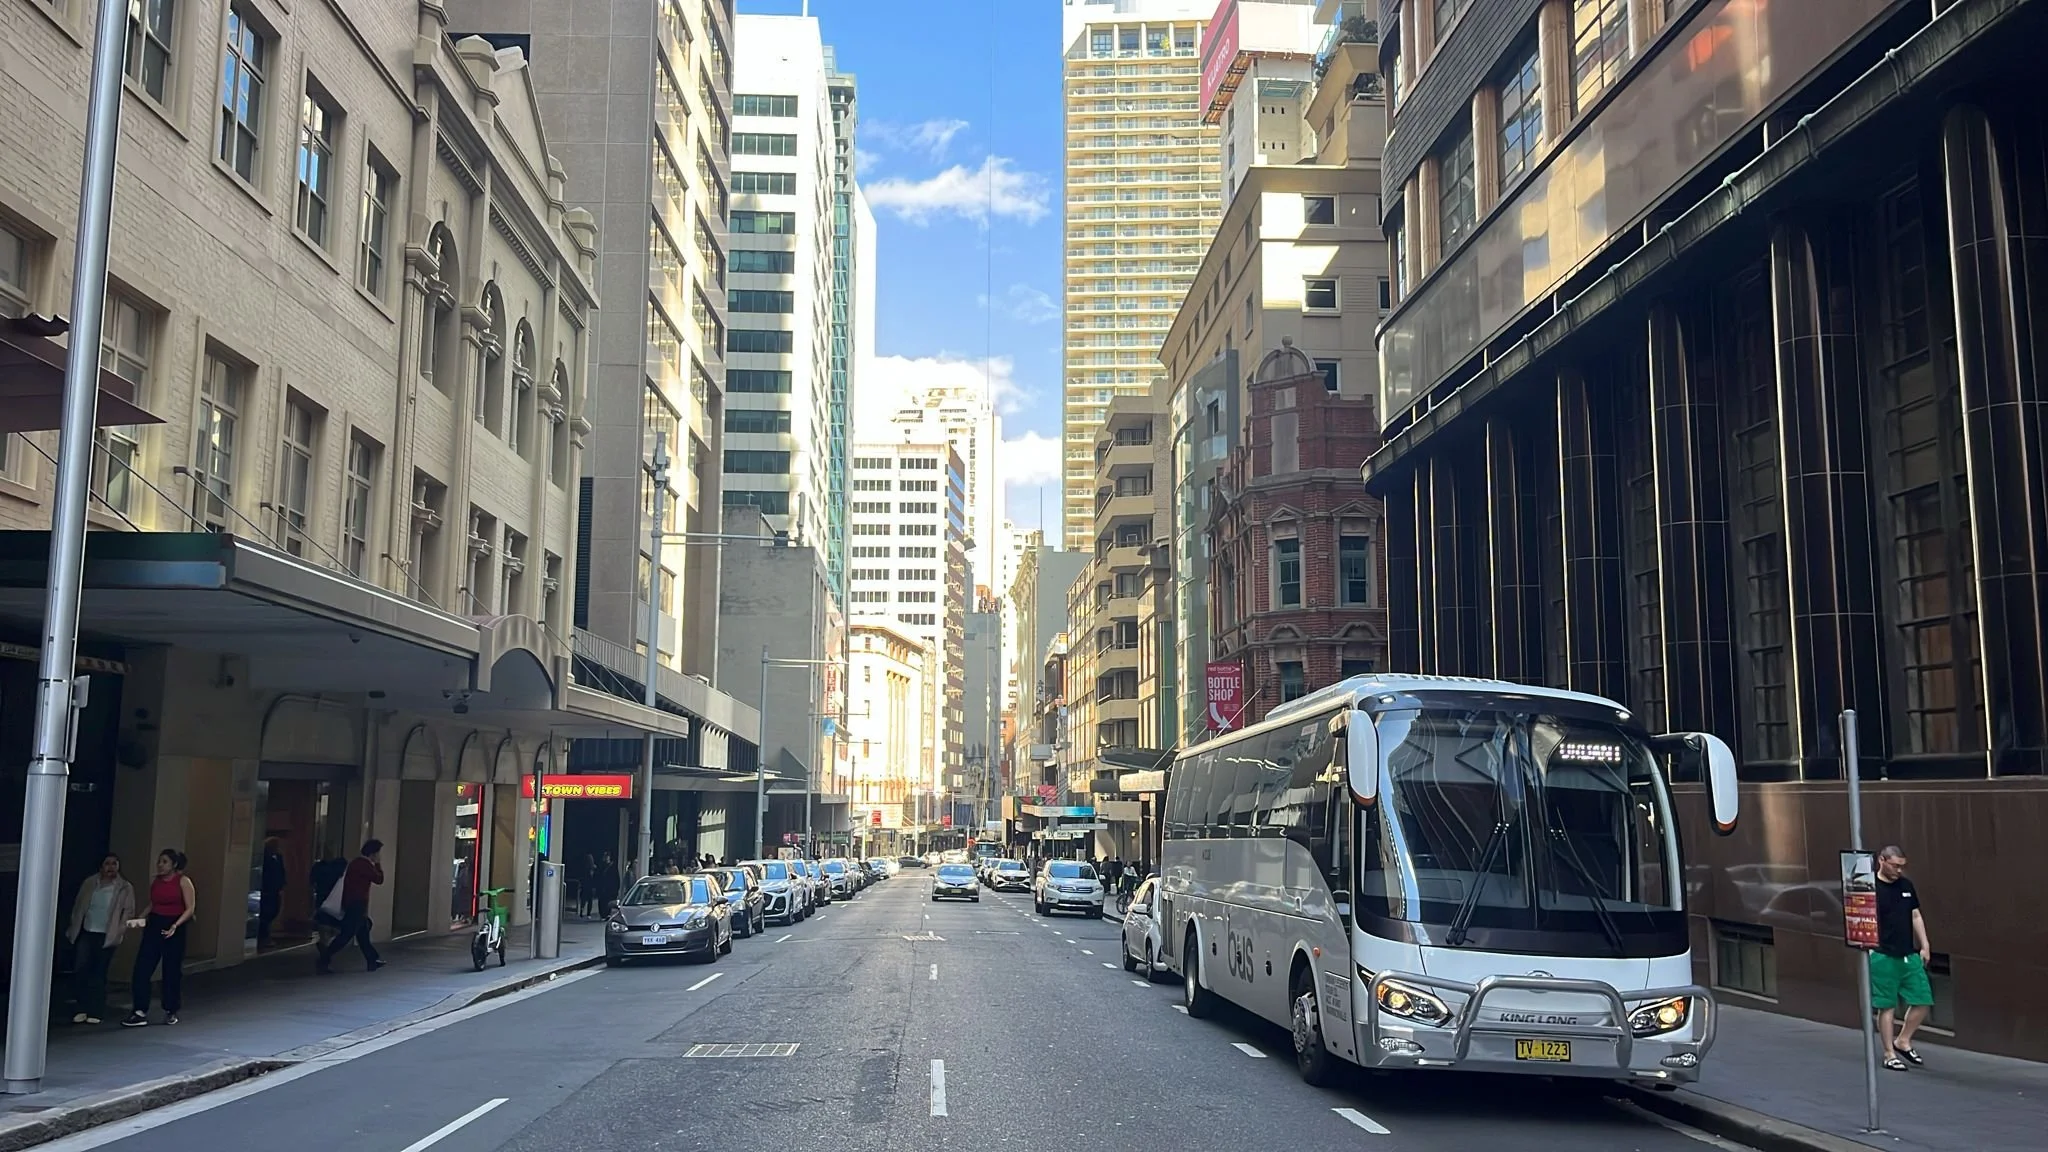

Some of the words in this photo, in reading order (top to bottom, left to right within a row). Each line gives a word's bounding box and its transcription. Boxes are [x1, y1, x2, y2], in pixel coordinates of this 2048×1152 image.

[1208, 677, 1240, 689] BOTTLE
[1208, 689, 1234, 701] SHOP
[585, 784, 622, 796] VIBES
[1227, 912, 1254, 984] bus
[1500, 1013, 1535, 1023] KING
[1537, 1015, 1577, 1025] LONG
